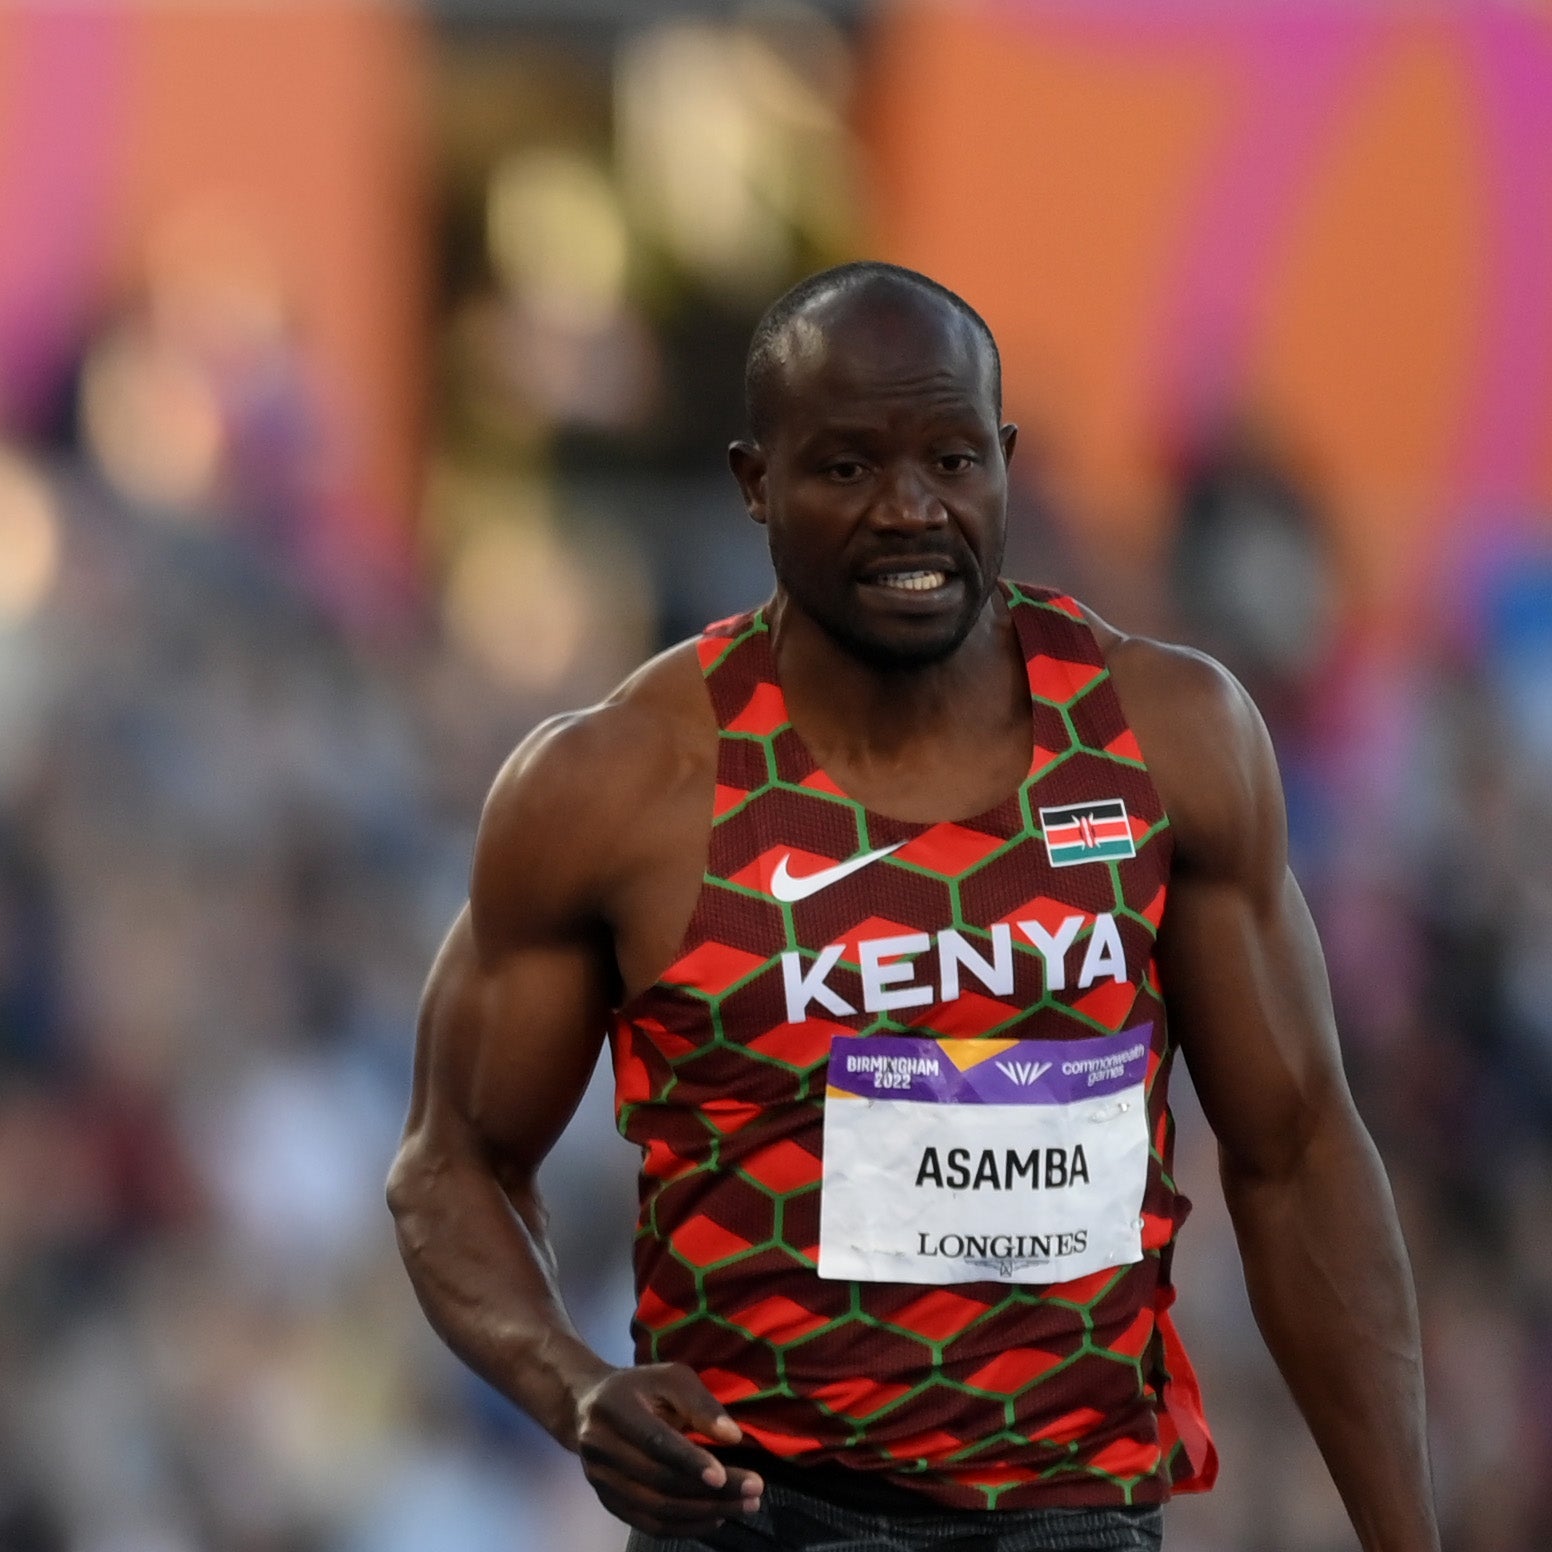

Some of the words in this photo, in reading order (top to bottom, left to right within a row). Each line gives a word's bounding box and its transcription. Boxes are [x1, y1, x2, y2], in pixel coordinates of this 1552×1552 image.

[781, 912, 1128, 1024] KENYA
[846, 1054, 940, 1077] BIRMINGHAM
[874, 1070, 912, 1090] 2022
[914, 1143, 1091, 1190] ASAMBA
[917, 1229, 1089, 1259] LONGINES
